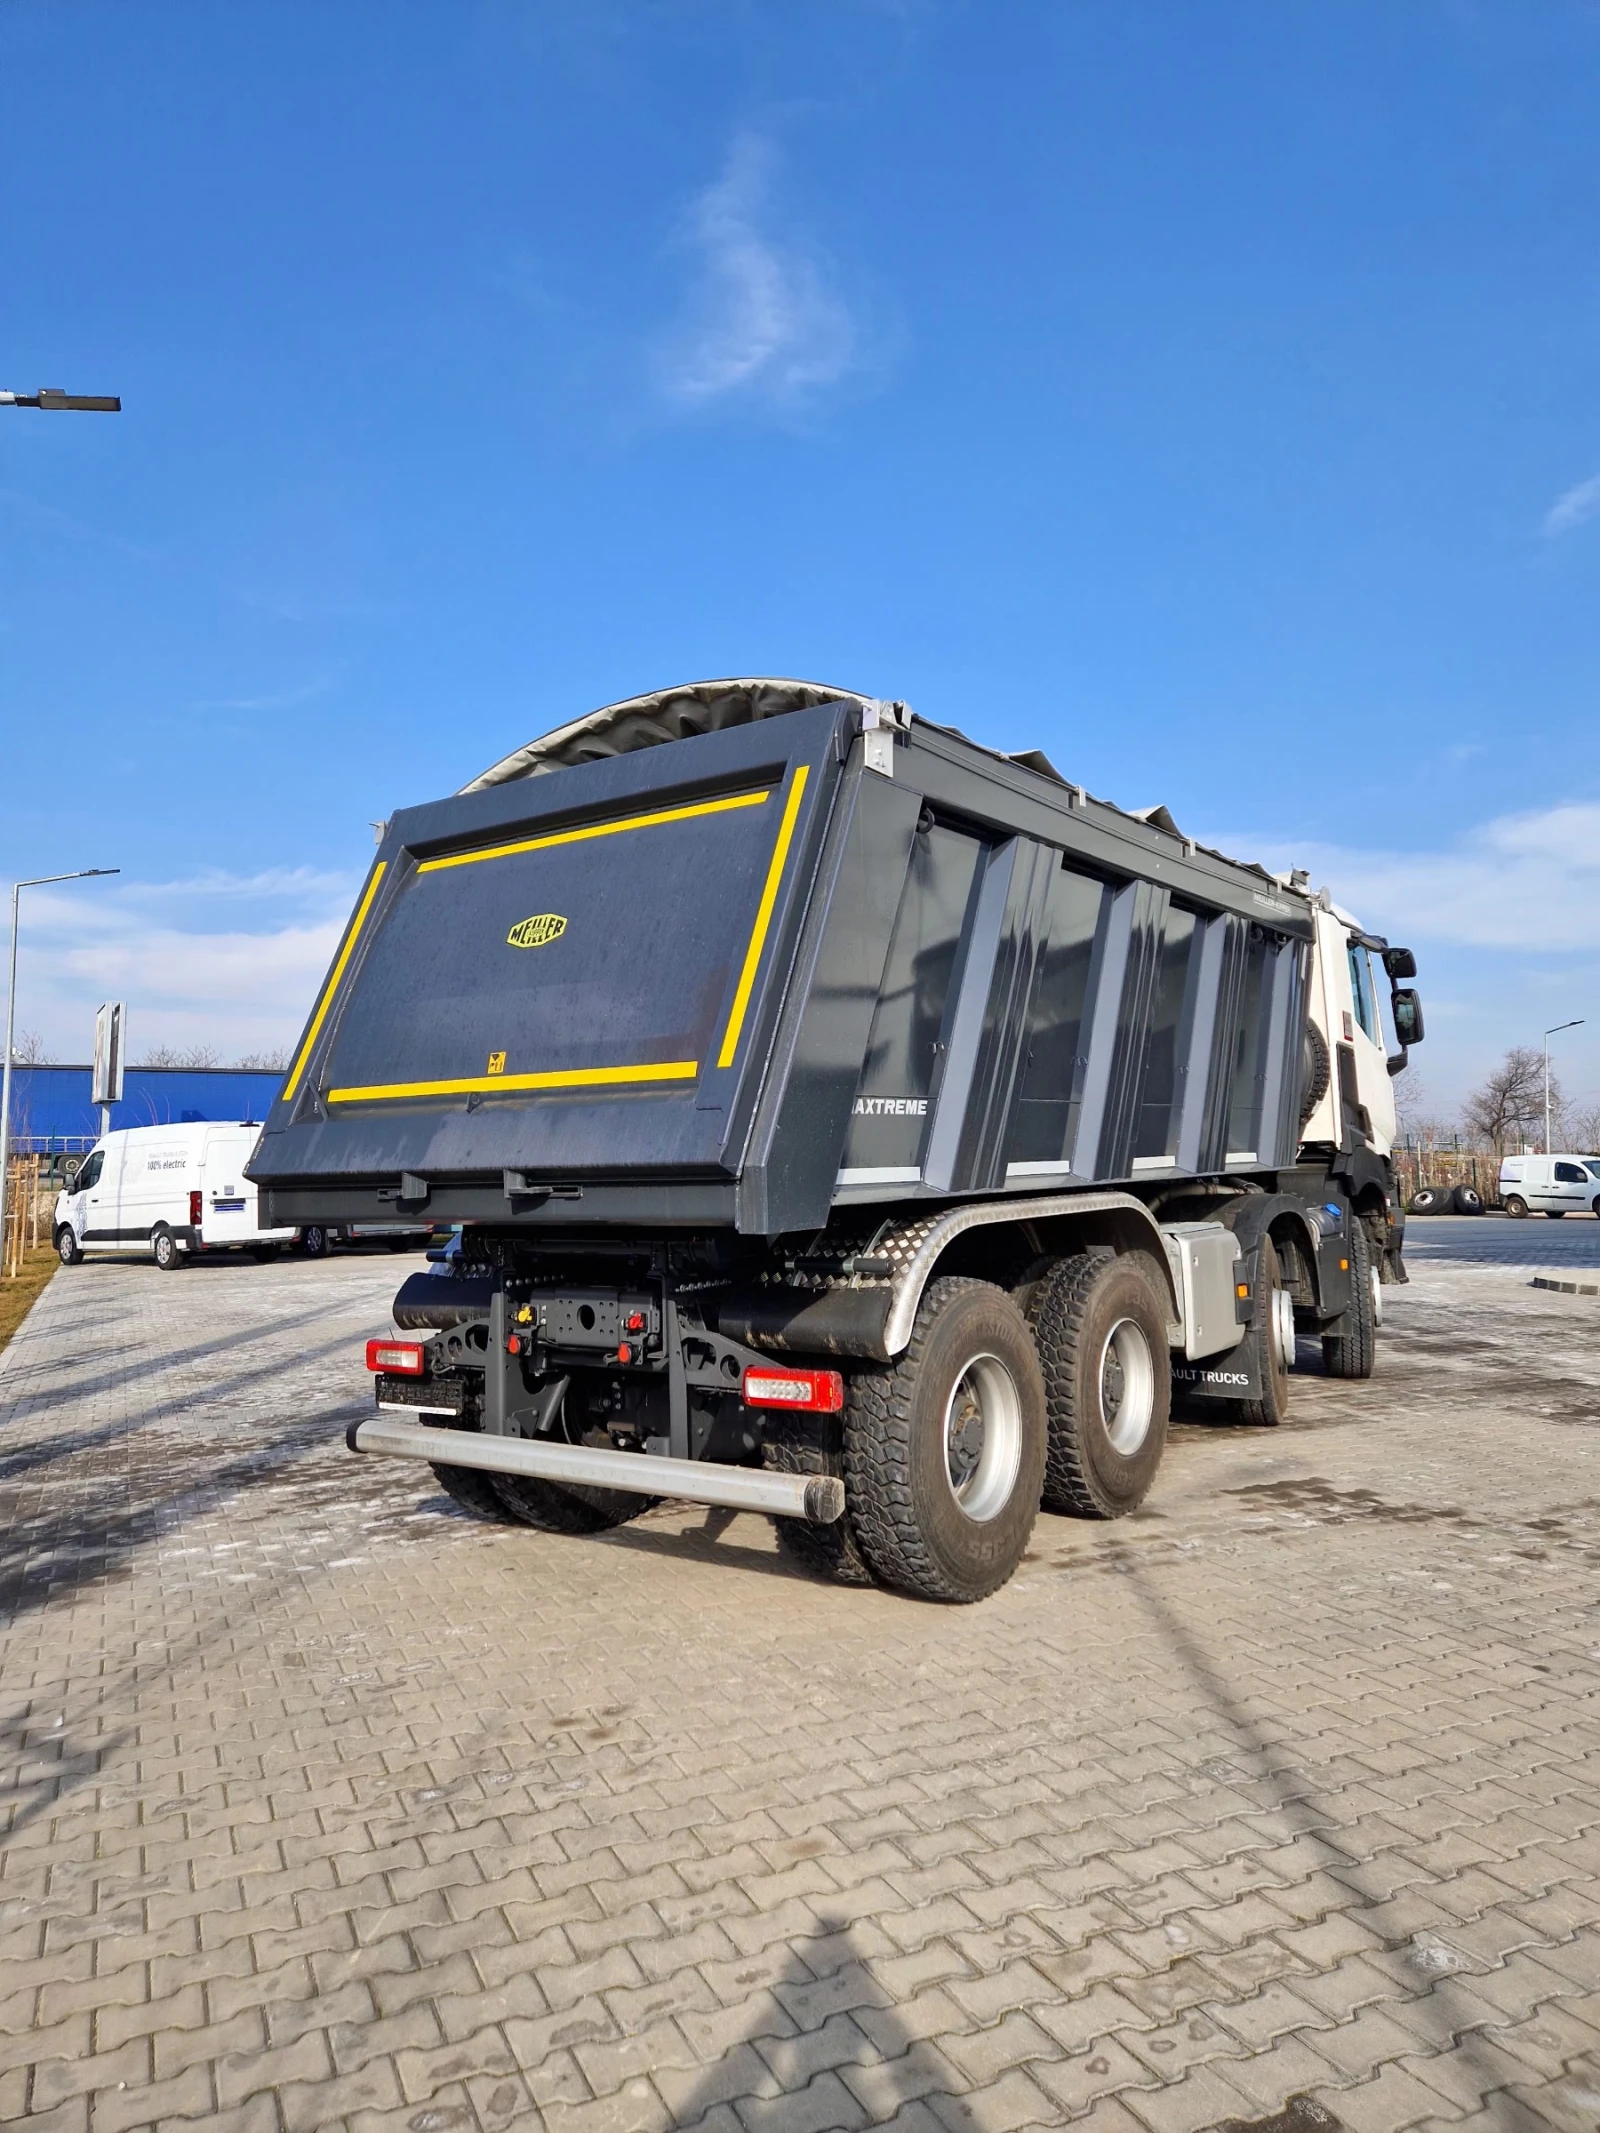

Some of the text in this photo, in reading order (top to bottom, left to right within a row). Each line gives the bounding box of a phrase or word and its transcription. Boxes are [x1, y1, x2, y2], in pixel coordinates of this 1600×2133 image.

[510, 917, 564, 944] MEILLER
[147, 1158, 186, 1170] 100% electric
[1200, 1371, 1249, 1385] TRUCKS
